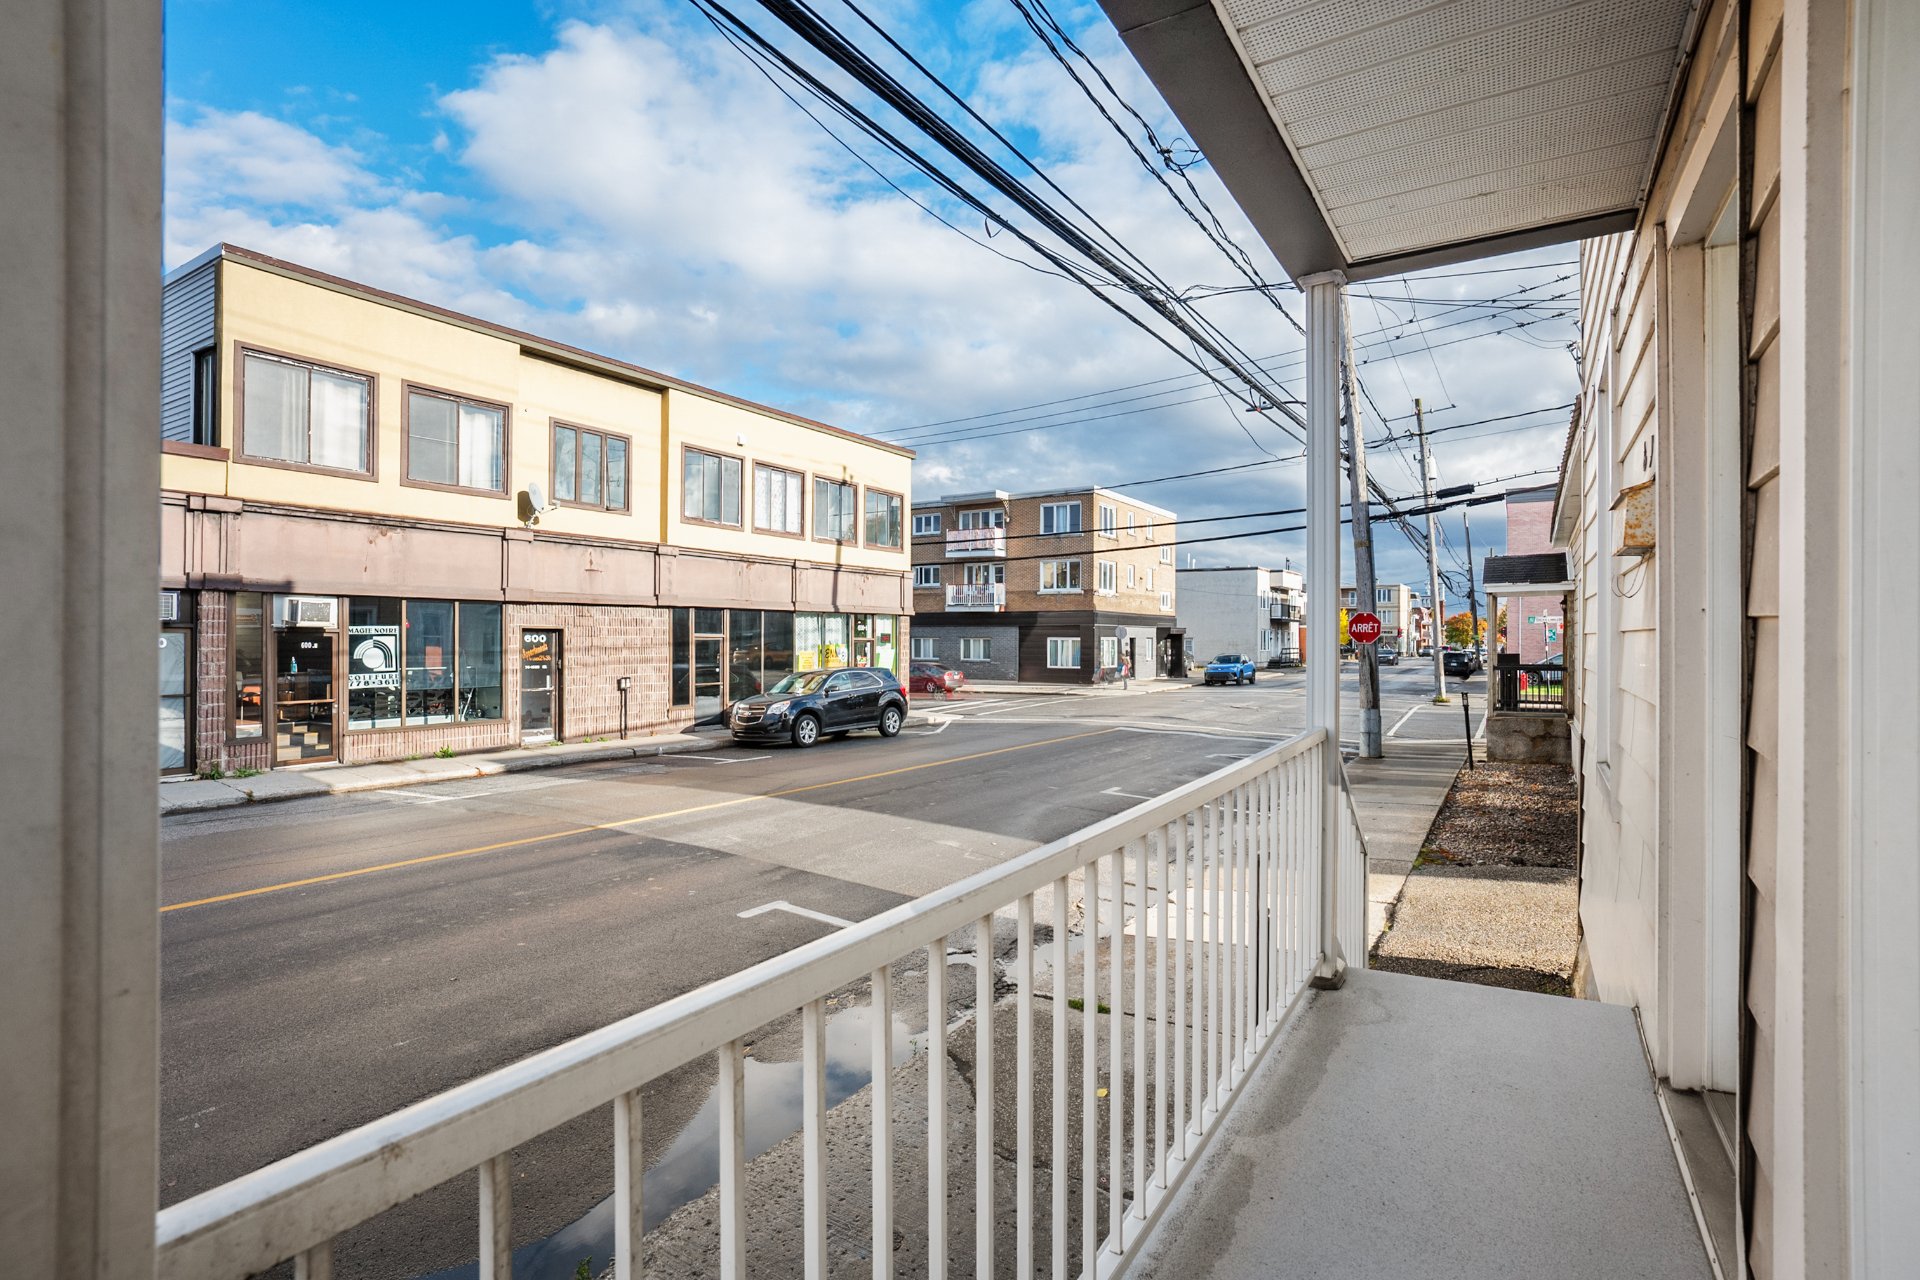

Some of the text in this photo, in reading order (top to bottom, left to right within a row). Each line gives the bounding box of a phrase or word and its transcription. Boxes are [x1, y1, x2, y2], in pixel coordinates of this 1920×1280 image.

[1351, 621, 1379, 633] ARRÊT
[524, 634, 546, 642] 600
[348, 673, 399, 681] COIFFURE
